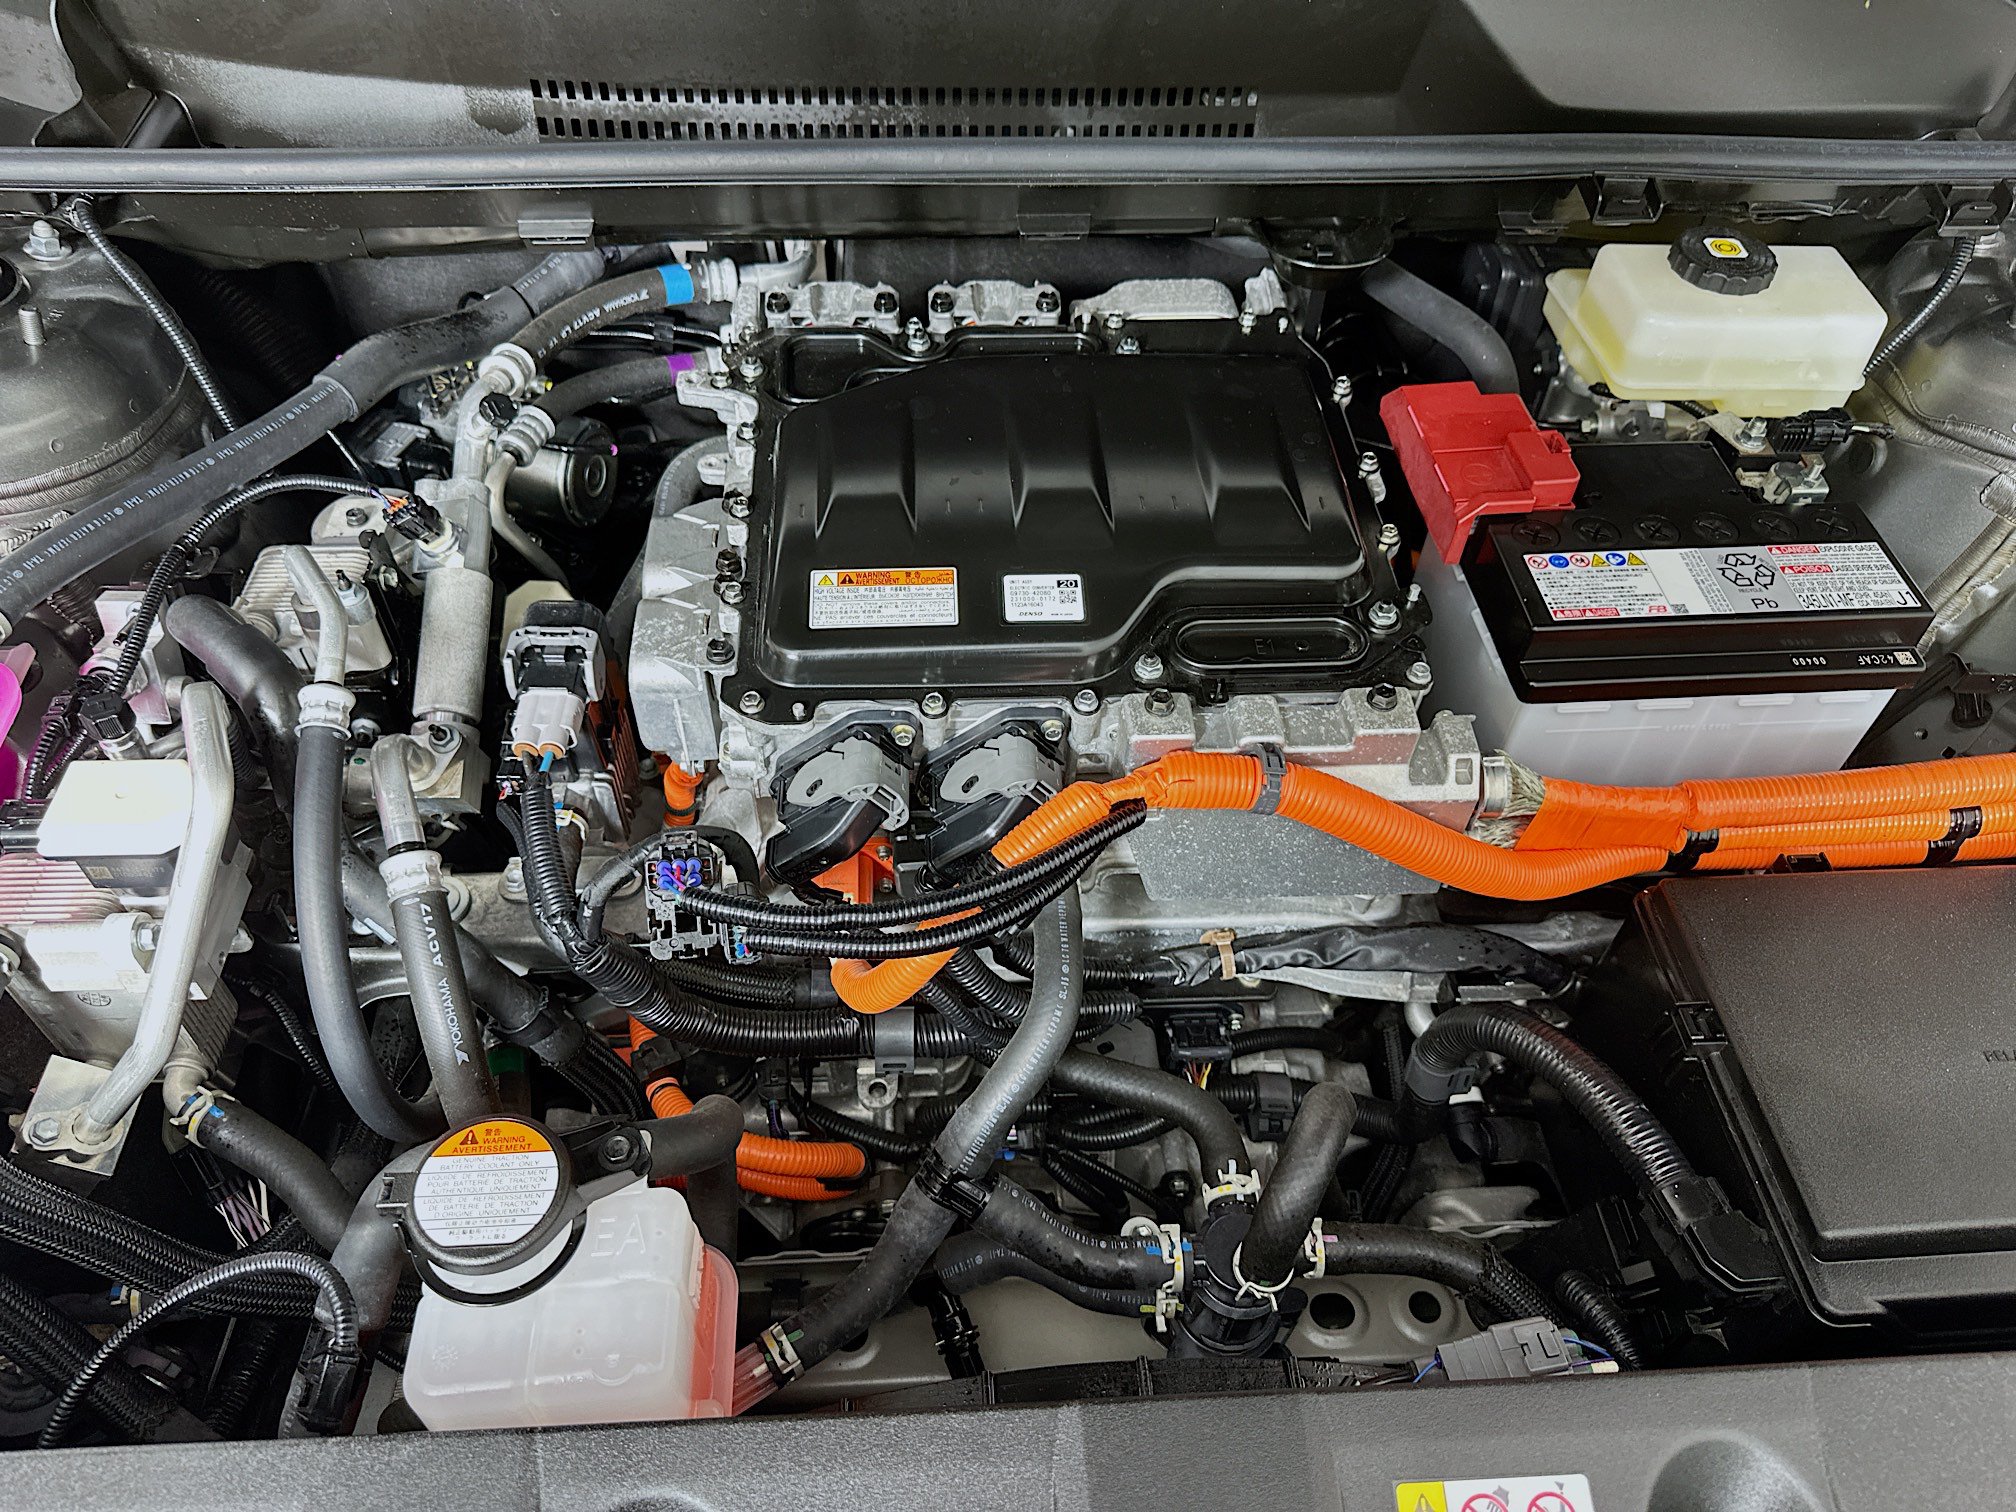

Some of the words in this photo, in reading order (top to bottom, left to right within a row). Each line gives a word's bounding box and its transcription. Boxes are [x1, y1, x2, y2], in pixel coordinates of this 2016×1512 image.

[573, 307, 600, 331] ACV17
[1793, 565, 1831, 573] POISON
[855, 571, 892, 579] WARNING
[855, 577, 900, 585] AVERTISSEMENT
[1751, 598, 1778, 609] Pb
[1896, 591, 1918, 606] J1
[420, 903, 444, 967] ACV17
[1029, 1035, 1050, 1064] WATER
[1059, 922, 1068, 941] WATER
[438, 977, 463, 1049] YOKOHAMA
[484, 1128, 502, 1136] 警告
[483, 1136, 526, 1144] WARNING
[452, 1143, 532, 1154] AVERTISSEMENT
[452, 1156, 486, 1164] GENUINE
[492, 1154, 530, 1162] TRACTION
[440, 1163, 474, 1171] BATTERY
[478, 1162, 515, 1170] COOLANT
[427, 1173, 458, 1181] LIQUIDE
[476, 1169, 549, 1178] REFROIDISSEMENT
[427, 1180, 449, 1188] POUR
[453, 1179, 489, 1187] BATTERIE
[509, 1176, 547, 1184] TRACTION
[431, 1186, 485, 1195] AUTHENTIQUE
[490, 1183, 541, 1192] UNIQUEMENT
[423, 1197, 454, 1205] LIQUIDE
[473, 1192, 546, 1202] REFROIDISSEMENT
[443, 1202, 480, 1210] BATTERIE
[484, 1201, 495, 1209] DE
[478, 1207, 531, 1216] UNIQUEMENT
